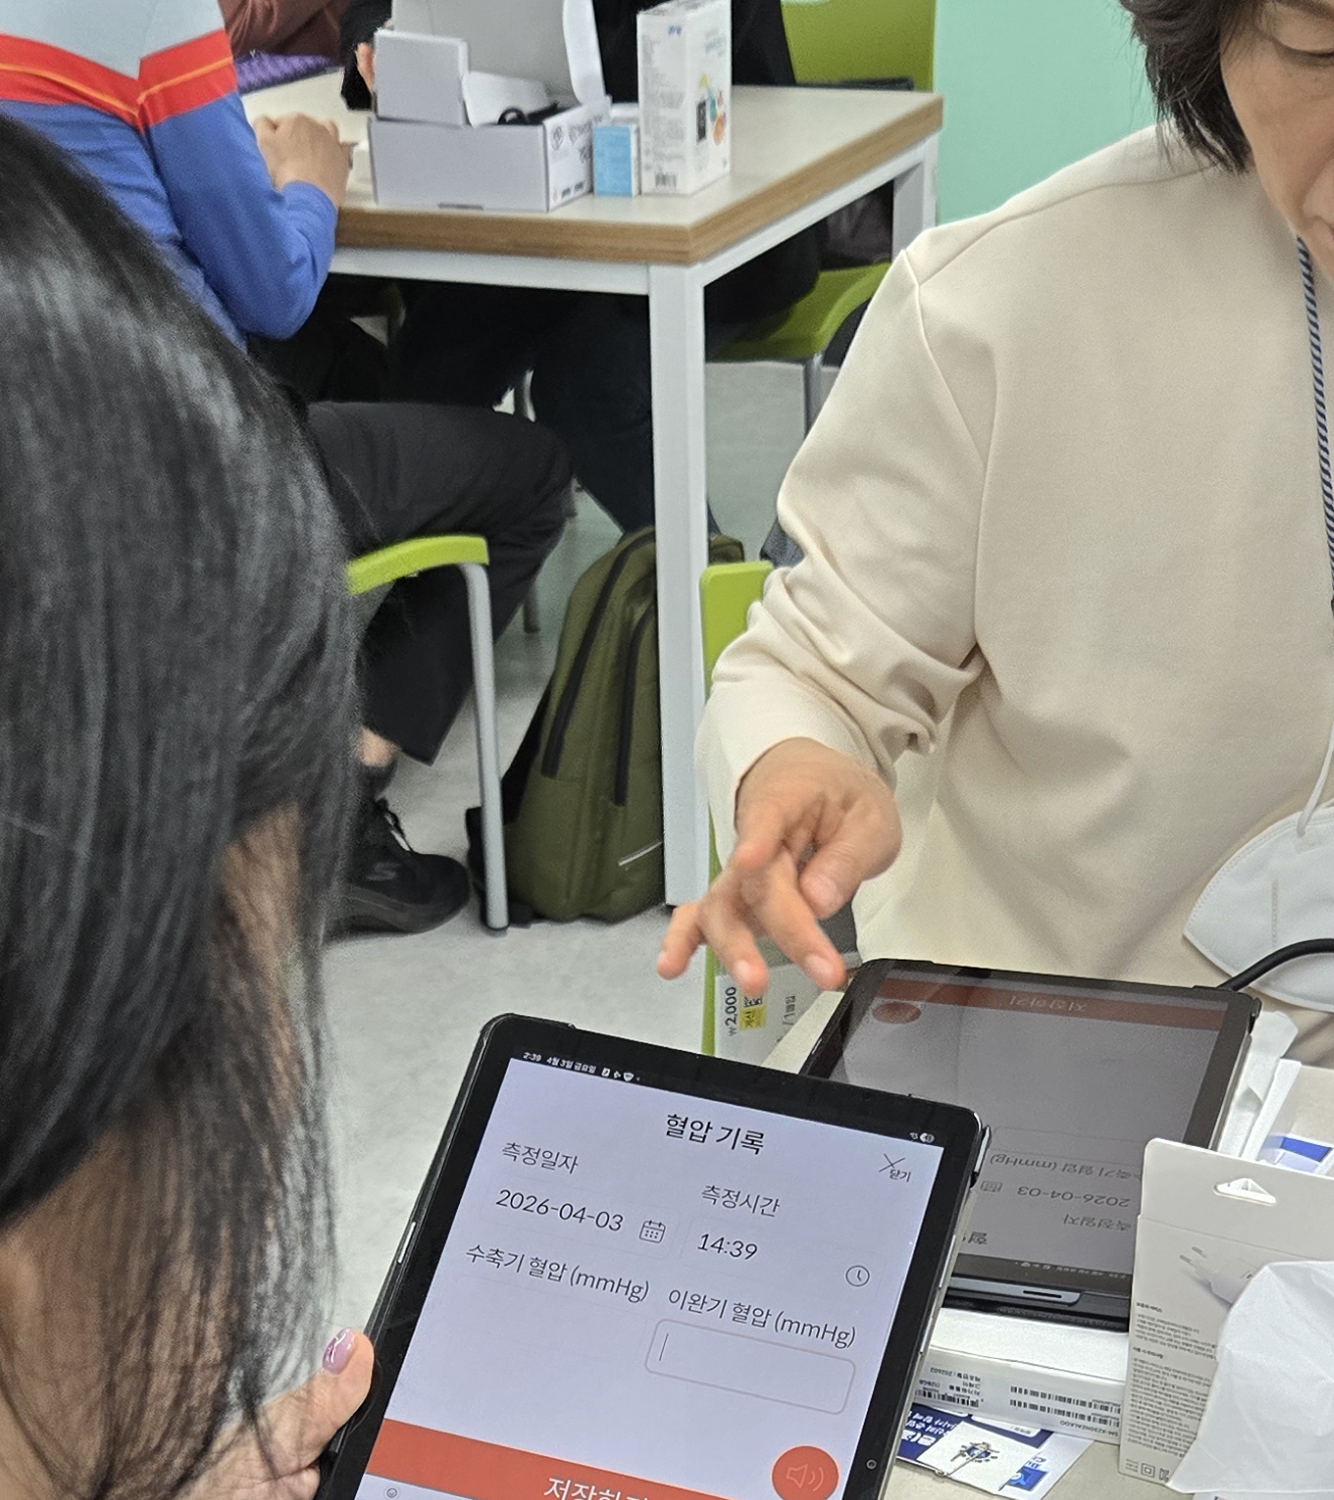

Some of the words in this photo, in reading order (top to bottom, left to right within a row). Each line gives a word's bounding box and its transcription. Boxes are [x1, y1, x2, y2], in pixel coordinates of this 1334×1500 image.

[523, 1052, 542, 1062] 2:39
[666, 1113, 713, 1144] 혈압
[716, 1126, 765, 1155] 기록
[502, 1142, 579, 1174] 측정일자
[889, 1168, 912, 1182] 닫기
[495, 1189, 624, 1231] 2026-04-03
[701, 1185, 780, 1217] 측정시간
[1017, 1186, 1131, 1208] 2026-04-03
[697, 1233, 758, 1260] 14:39
[466, 1244, 525, 1273] 수축기
[529, 1257, 567, 1282] 혈압
[570, 1265, 649, 1303] (mmHg)
[668, 1289, 728, 1319] 이완기
[732, 1302, 771, 1328] 혈압
[775, 1311, 856, 1349] (mmHg)
